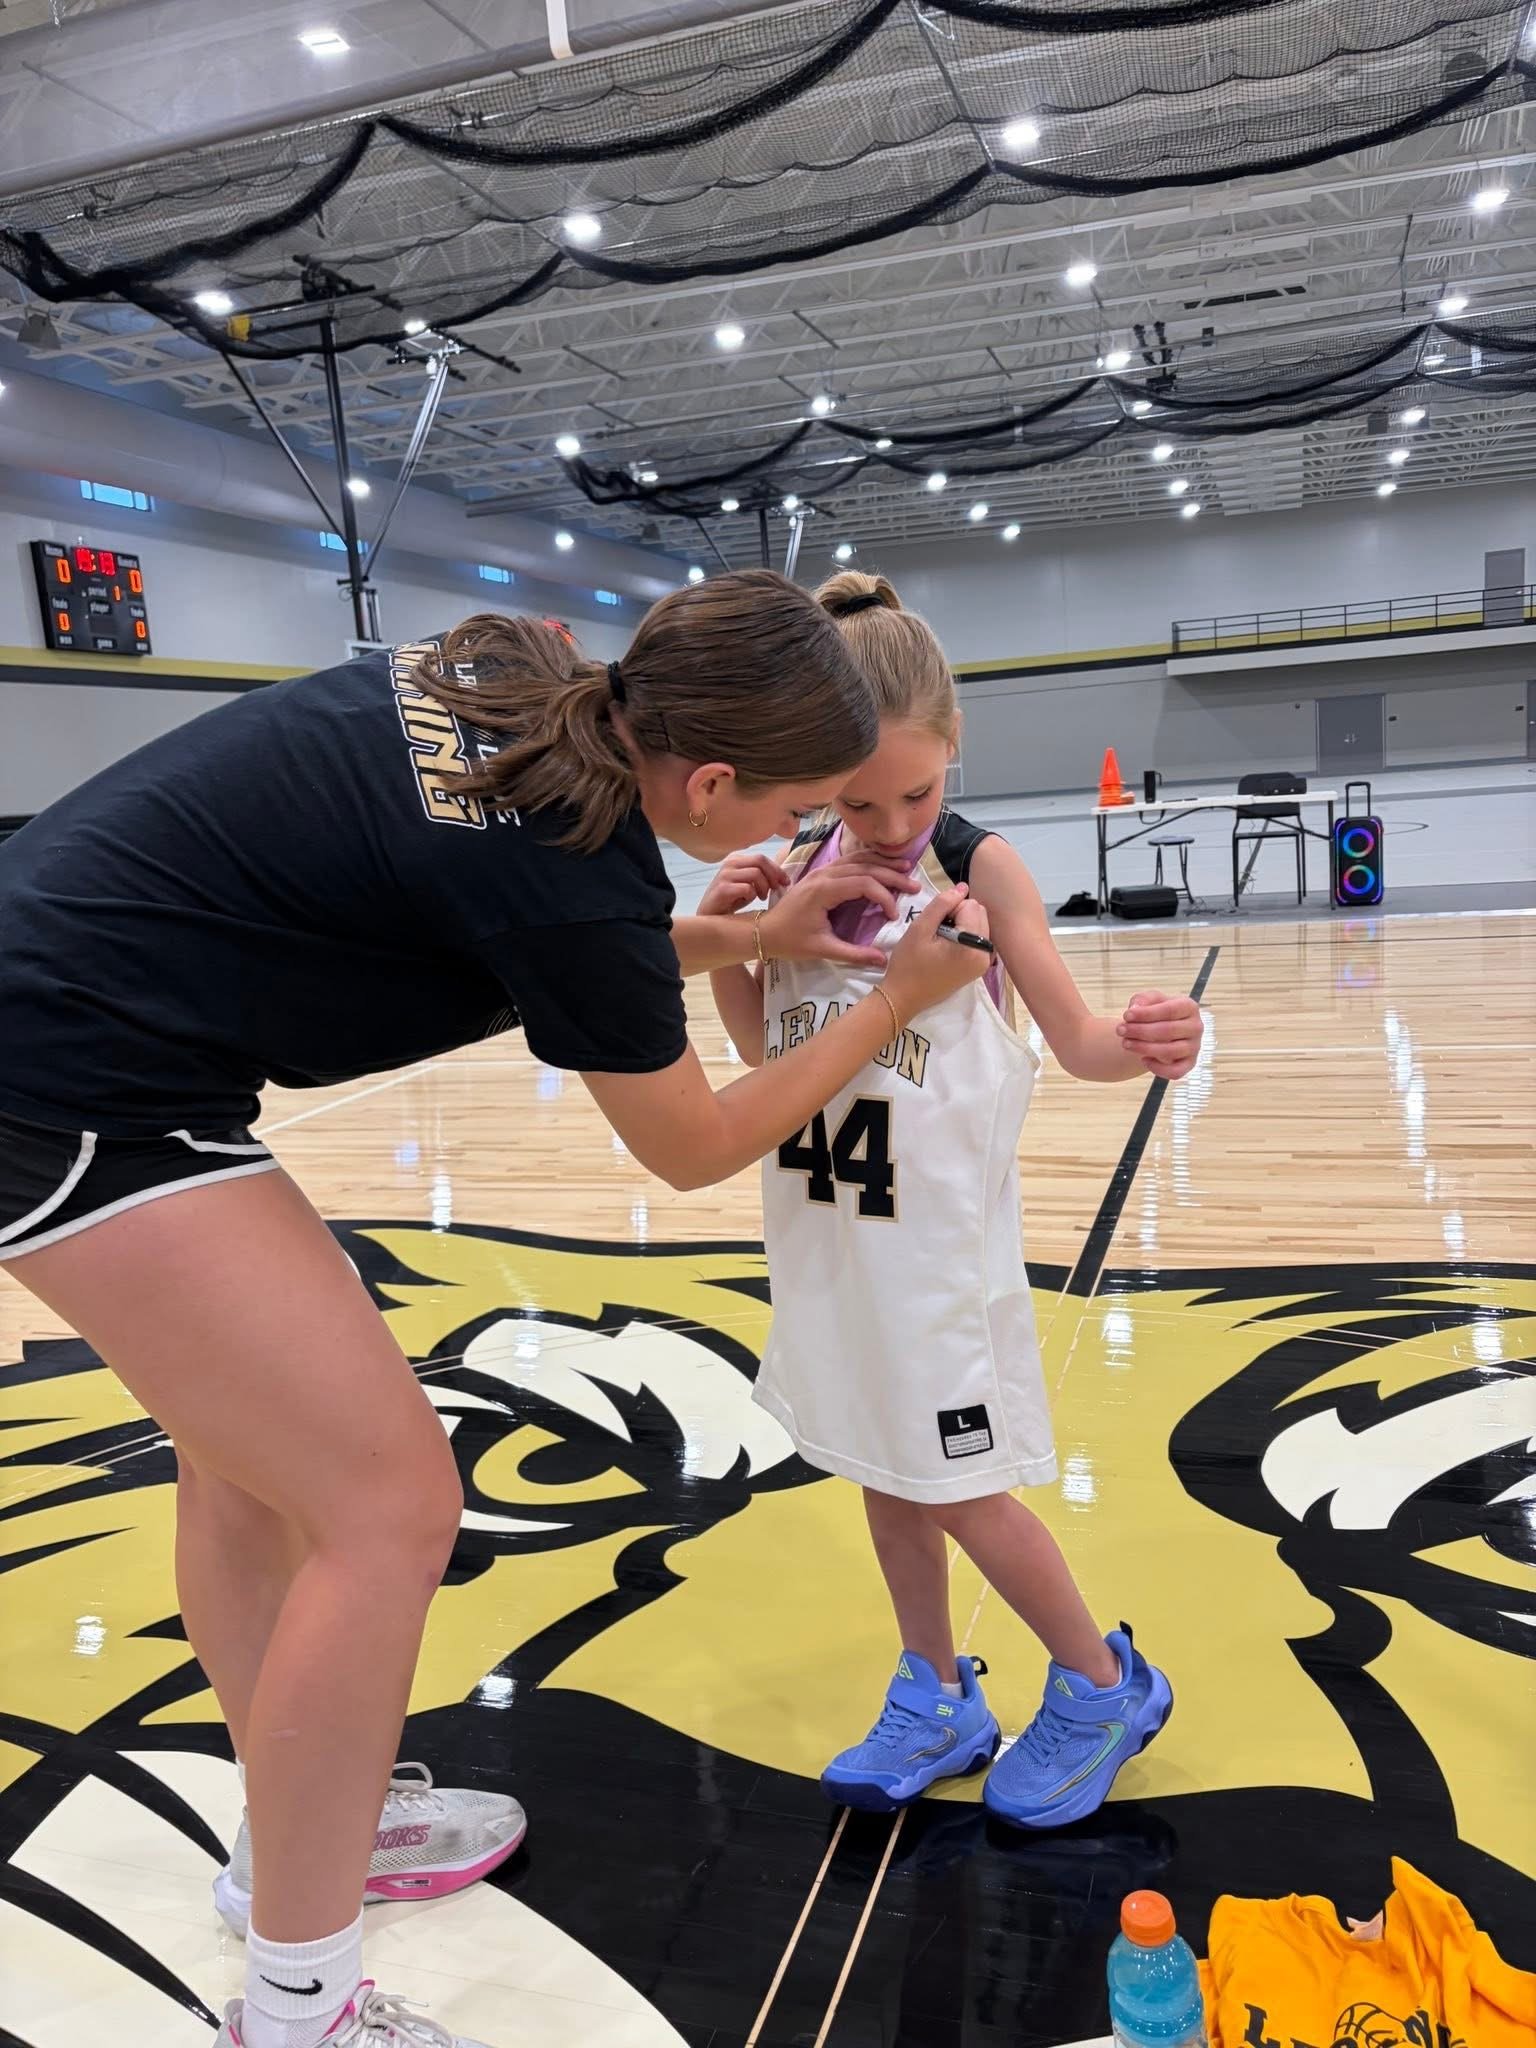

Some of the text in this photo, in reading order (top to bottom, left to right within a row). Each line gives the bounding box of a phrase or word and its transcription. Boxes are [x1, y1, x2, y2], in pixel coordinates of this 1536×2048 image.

[57, 559, 71, 583] 0
[129, 569, 142, 593] 0
[764, 1001, 931, 1088] LEBAON
[776, 1093, 898, 1223] 44
[957, 1415, 971, 1429] L
